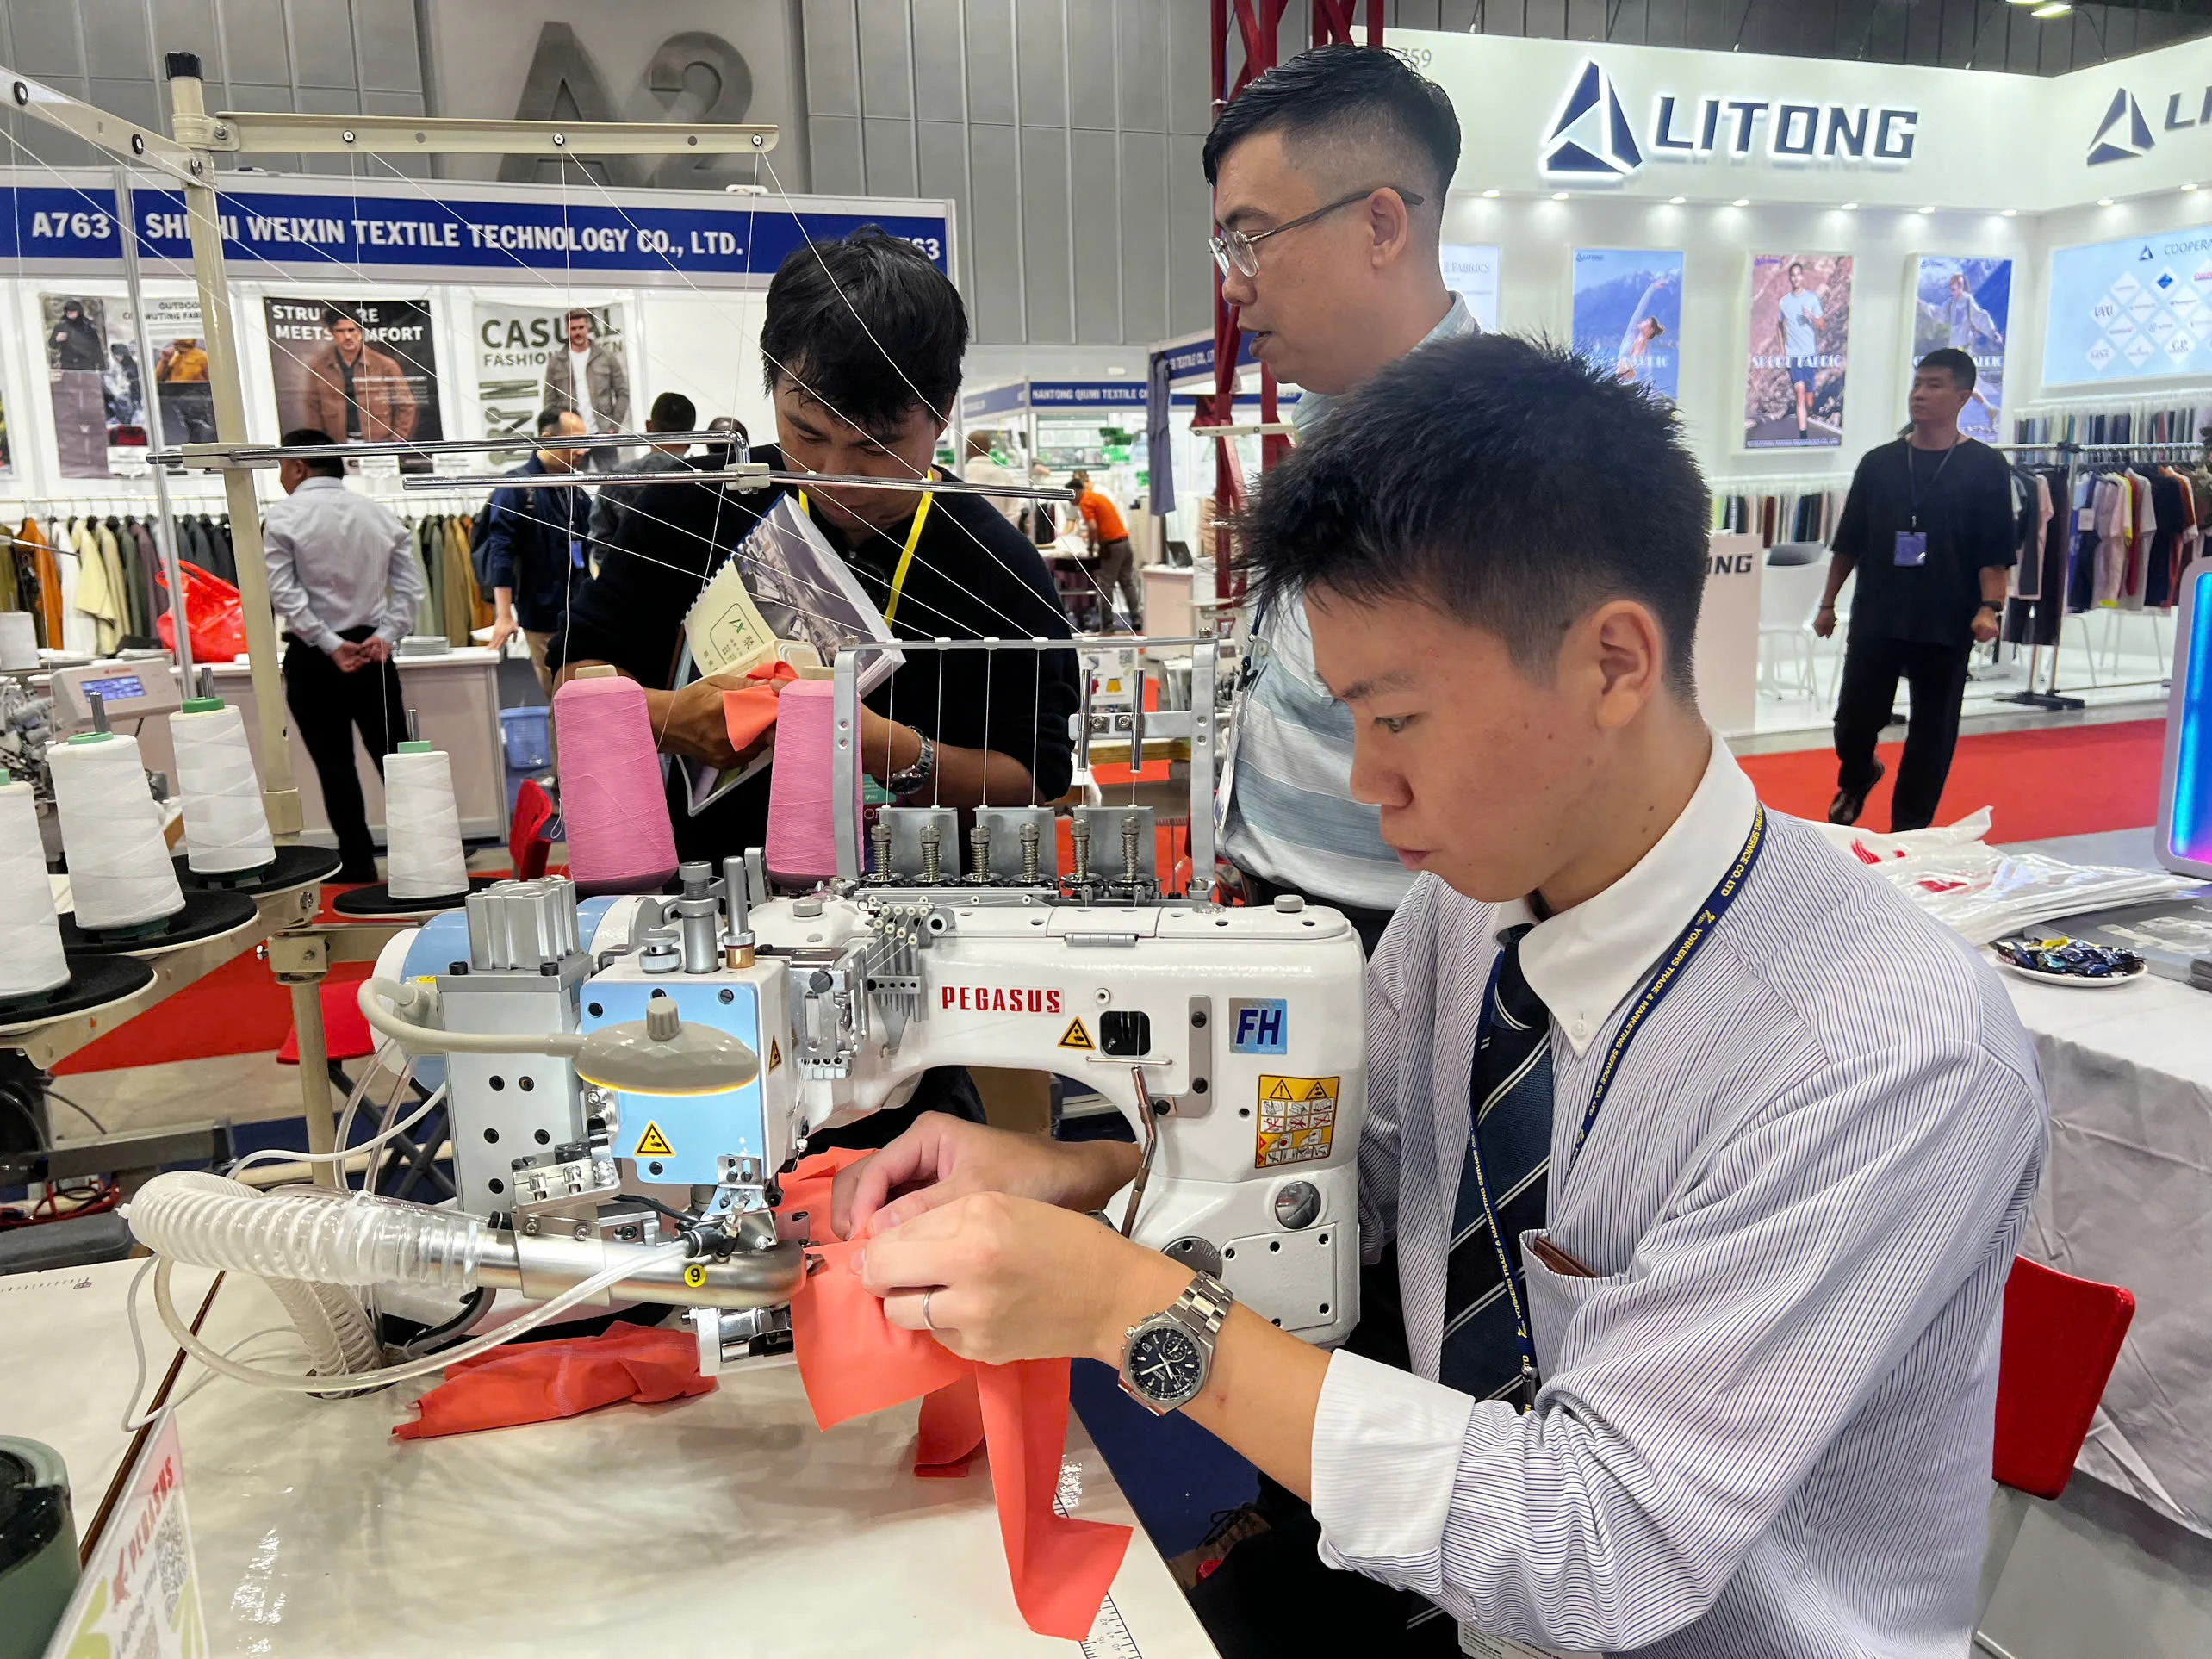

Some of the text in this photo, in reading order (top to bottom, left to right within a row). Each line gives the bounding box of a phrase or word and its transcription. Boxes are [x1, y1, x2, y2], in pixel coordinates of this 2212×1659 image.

[496, 21, 760, 190] A2
[1654, 96, 1919, 161] LITONG
[32, 212, 111, 239] A763
[247, 215, 345, 244] WEIXIN
[351, 220, 460, 247] TEXTILE
[468, 224, 629, 252] TECHNOLOGY
[637, 230, 685, 257] CO.,
[692, 230, 743, 256] LTD.
[275, 325, 334, 341] MEETS
[484, 351, 552, 368] FASHIO
[1740, 830, 1760, 865] SERVICE
[1720, 879, 1736, 897] LTD
[1670, 928, 1703, 966] YORKERS
[1650, 966, 1675, 995] TRADE
[941, 986, 1061, 1014] PEGASUS
[1235, 1008, 1282, 1045] FH
[1615, 1000, 1650, 1048] MARKETING
[1600, 1048, 1619, 1085] SERVICE
[690, 1268, 701, 1283] 9
